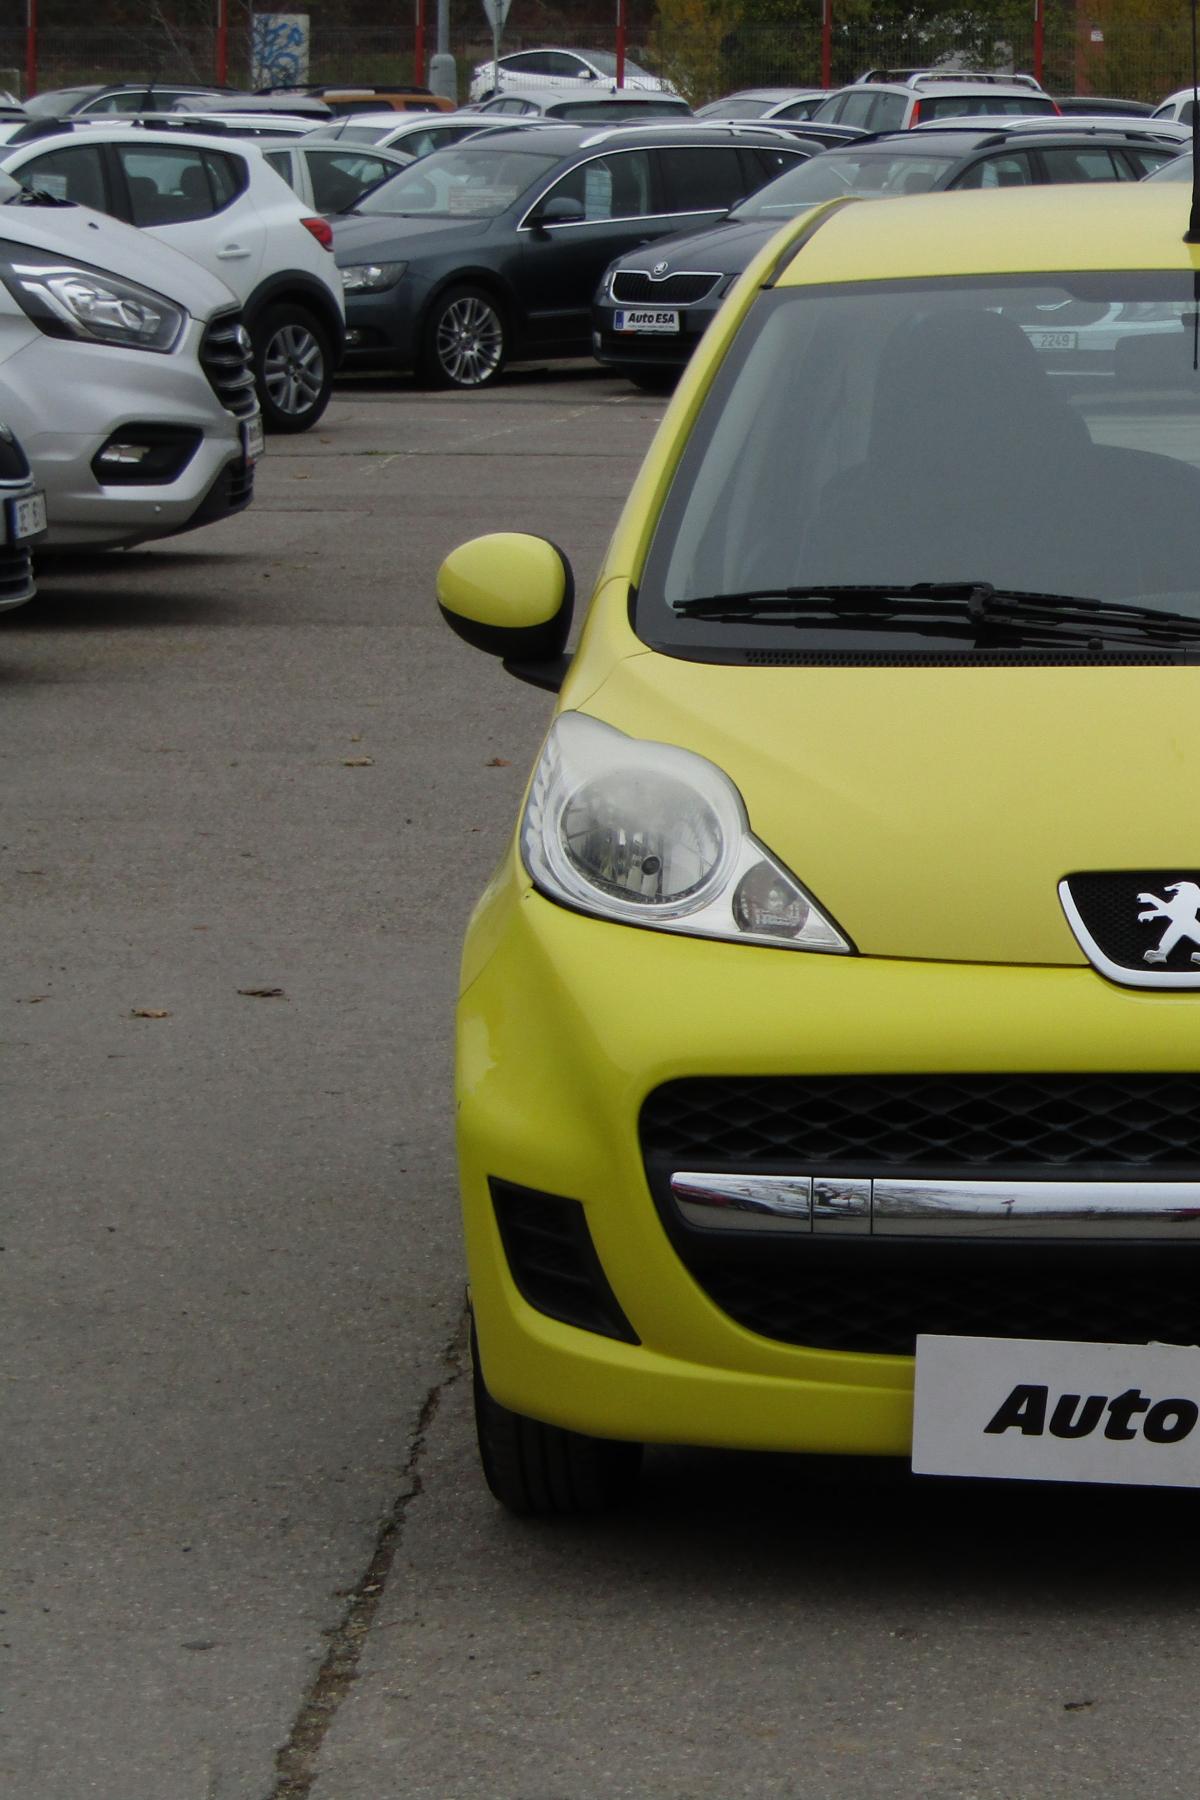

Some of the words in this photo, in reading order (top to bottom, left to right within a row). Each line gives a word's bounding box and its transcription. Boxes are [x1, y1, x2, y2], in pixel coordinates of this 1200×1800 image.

[628, 312, 654, 323] Auto
[655, 313, 675, 324] ESA
[984, 1384, 1200, 1444] Auto
